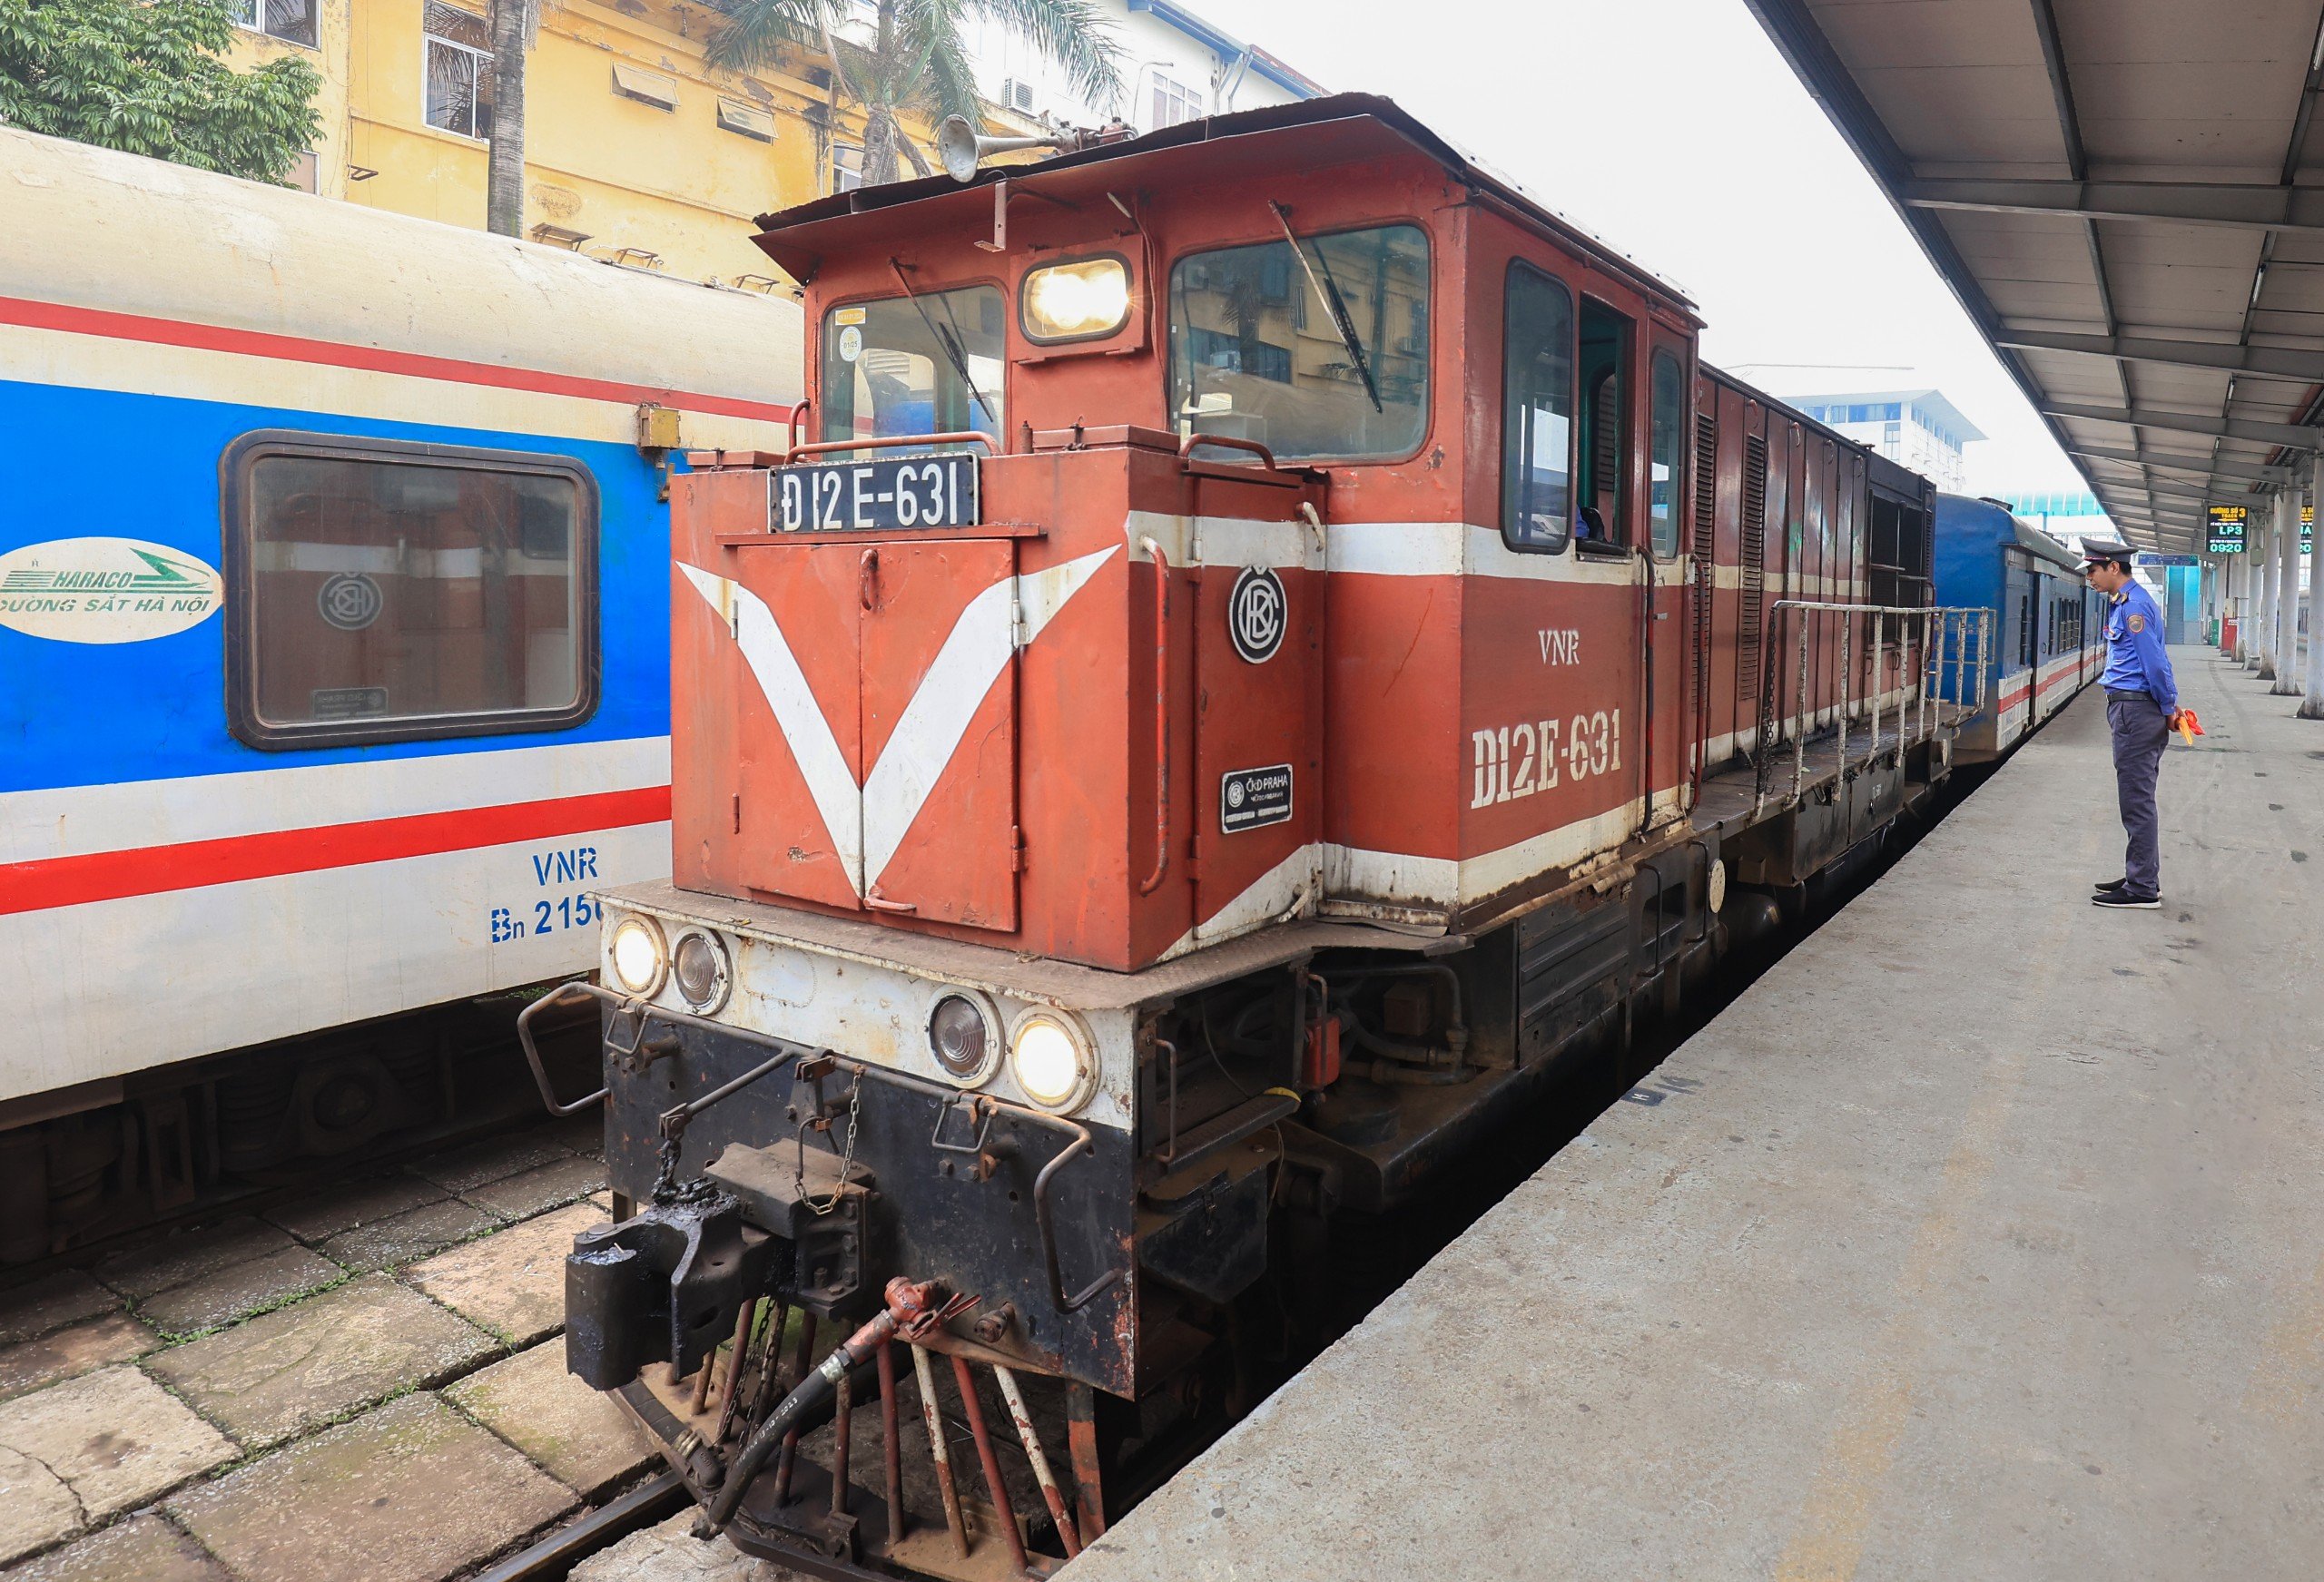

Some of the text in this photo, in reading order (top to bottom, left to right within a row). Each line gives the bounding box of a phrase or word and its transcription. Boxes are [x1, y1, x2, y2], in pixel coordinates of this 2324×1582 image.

[2239, 507, 2246, 517] 3
[2219, 526, 2242, 536] LP3
[52, 570, 133, 588] HARACO
[134, 595, 167, 613] HÀ
[171, 593, 211, 616] NỘI
[1538, 629, 1580, 666] VNR
[1471, 708, 1621, 810] D12E-631
[1263, 774, 1288, 791] PRAHA
[532, 847, 598, 886] VNR
[491, 908, 525, 943] Bn
